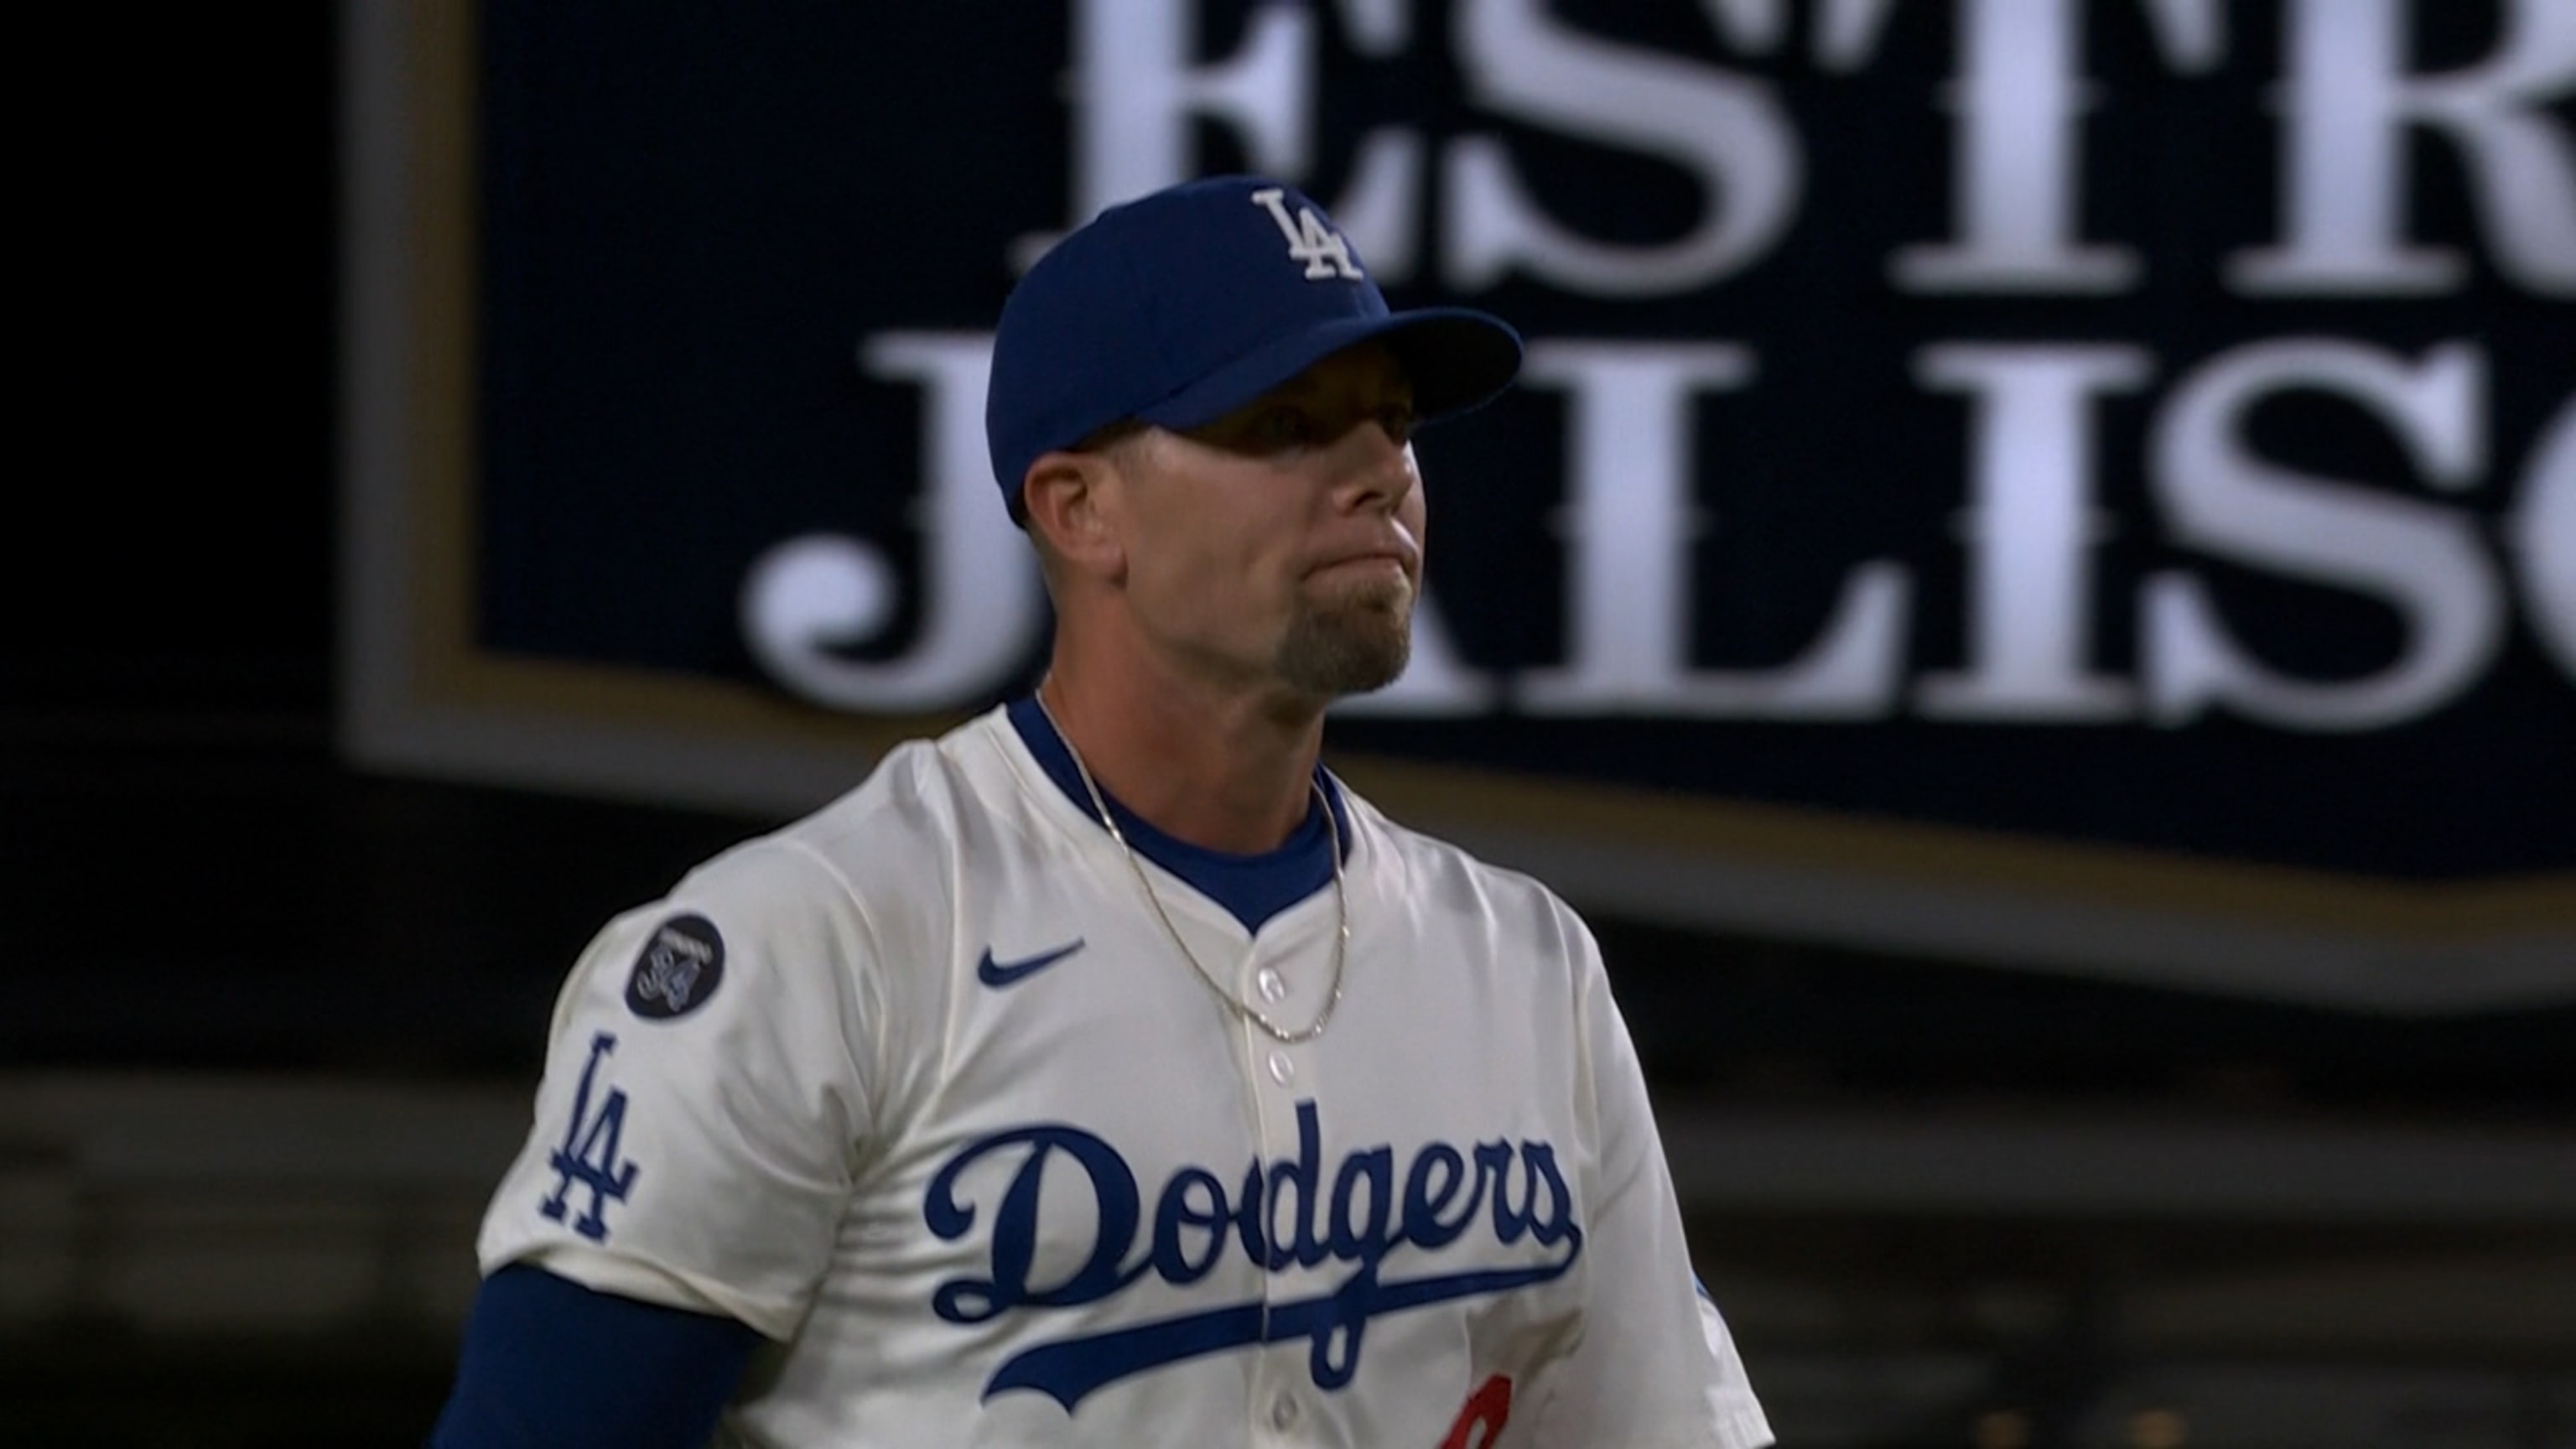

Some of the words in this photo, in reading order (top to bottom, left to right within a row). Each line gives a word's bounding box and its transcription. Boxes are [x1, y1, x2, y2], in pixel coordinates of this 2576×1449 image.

[1251, 187, 1365, 283] LA
[742, 332, 2576, 733] JLIS
[538, 1032, 640, 1243] LA
[923, 1098, 1583, 1394] Dodgers
